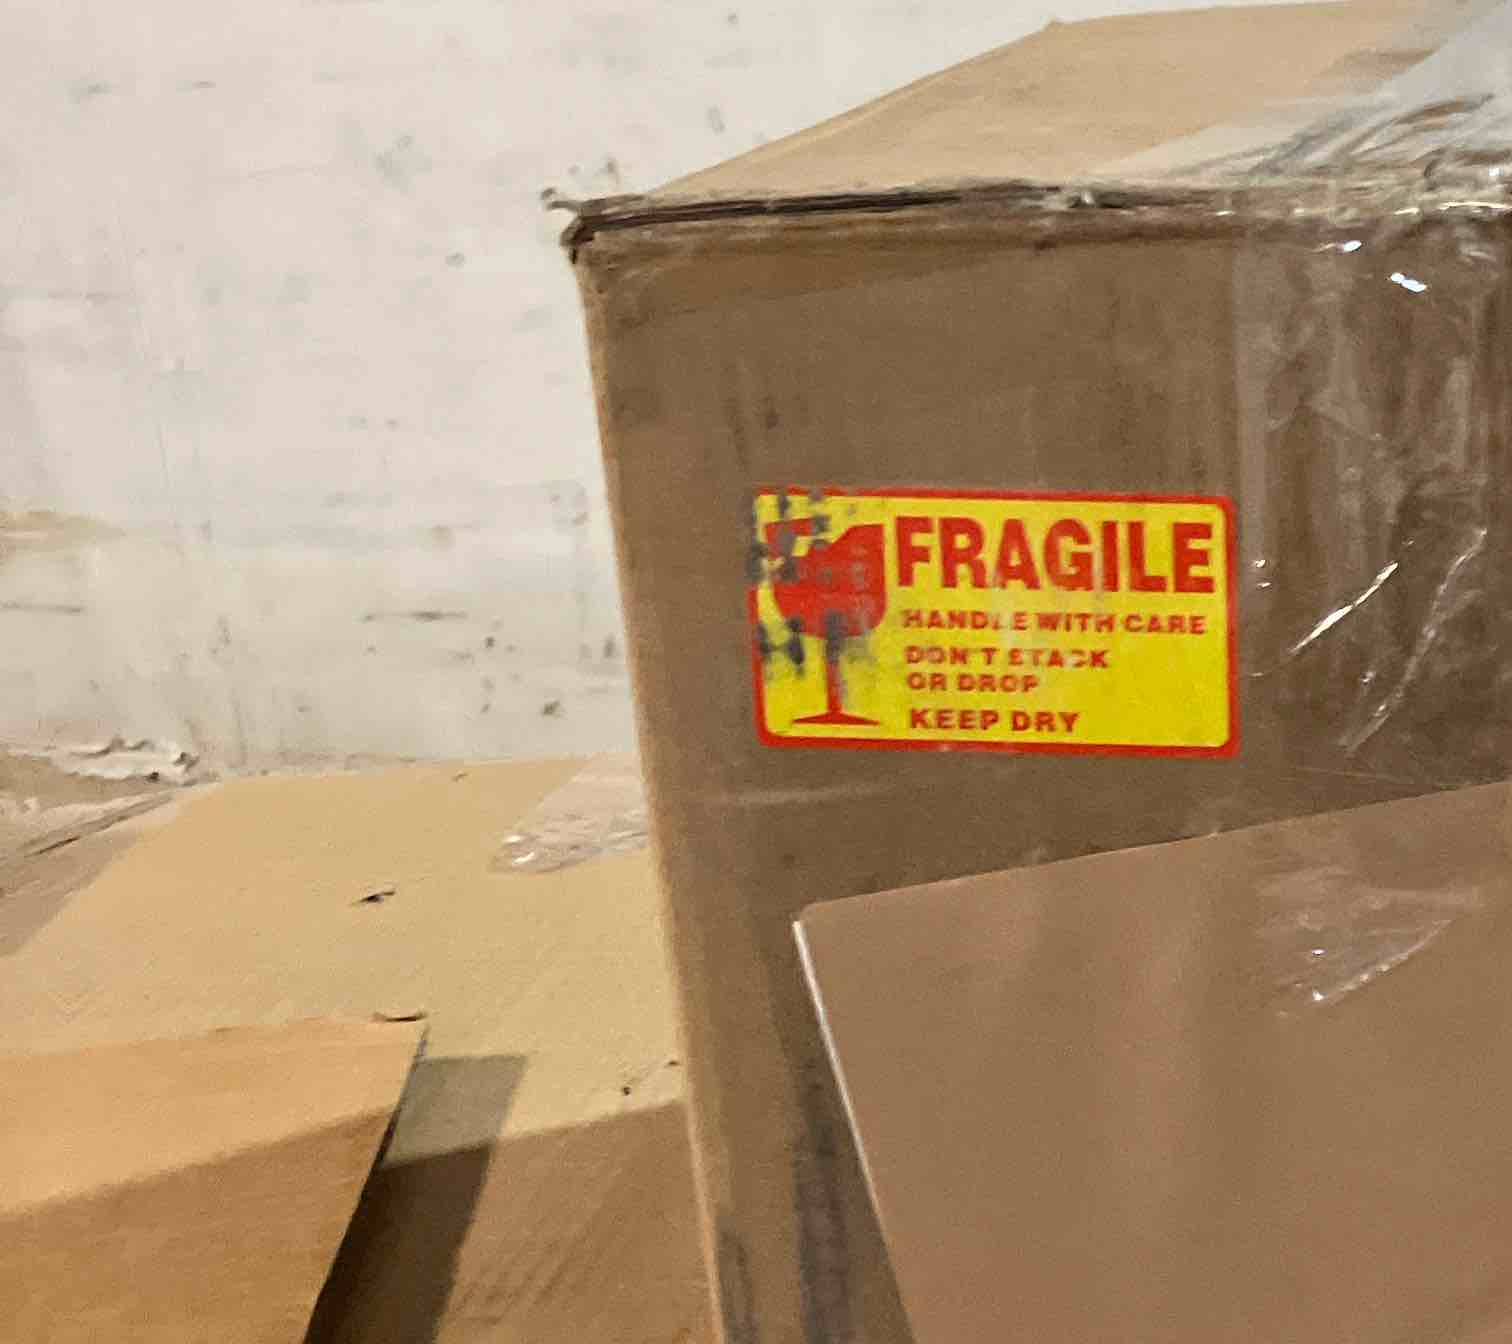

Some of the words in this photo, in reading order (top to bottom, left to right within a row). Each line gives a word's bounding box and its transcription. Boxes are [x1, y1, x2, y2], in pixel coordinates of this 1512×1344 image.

[896, 516, 1215, 593] FRAGILE
[1035, 612, 1115, 633] WITH
[1123, 613, 1207, 635] CARE
[906, 672, 948, 691] OR
[957, 674, 1040, 693] DROP
[909, 708, 999, 730] KEEP
[1011, 710, 1081, 733] DRY
